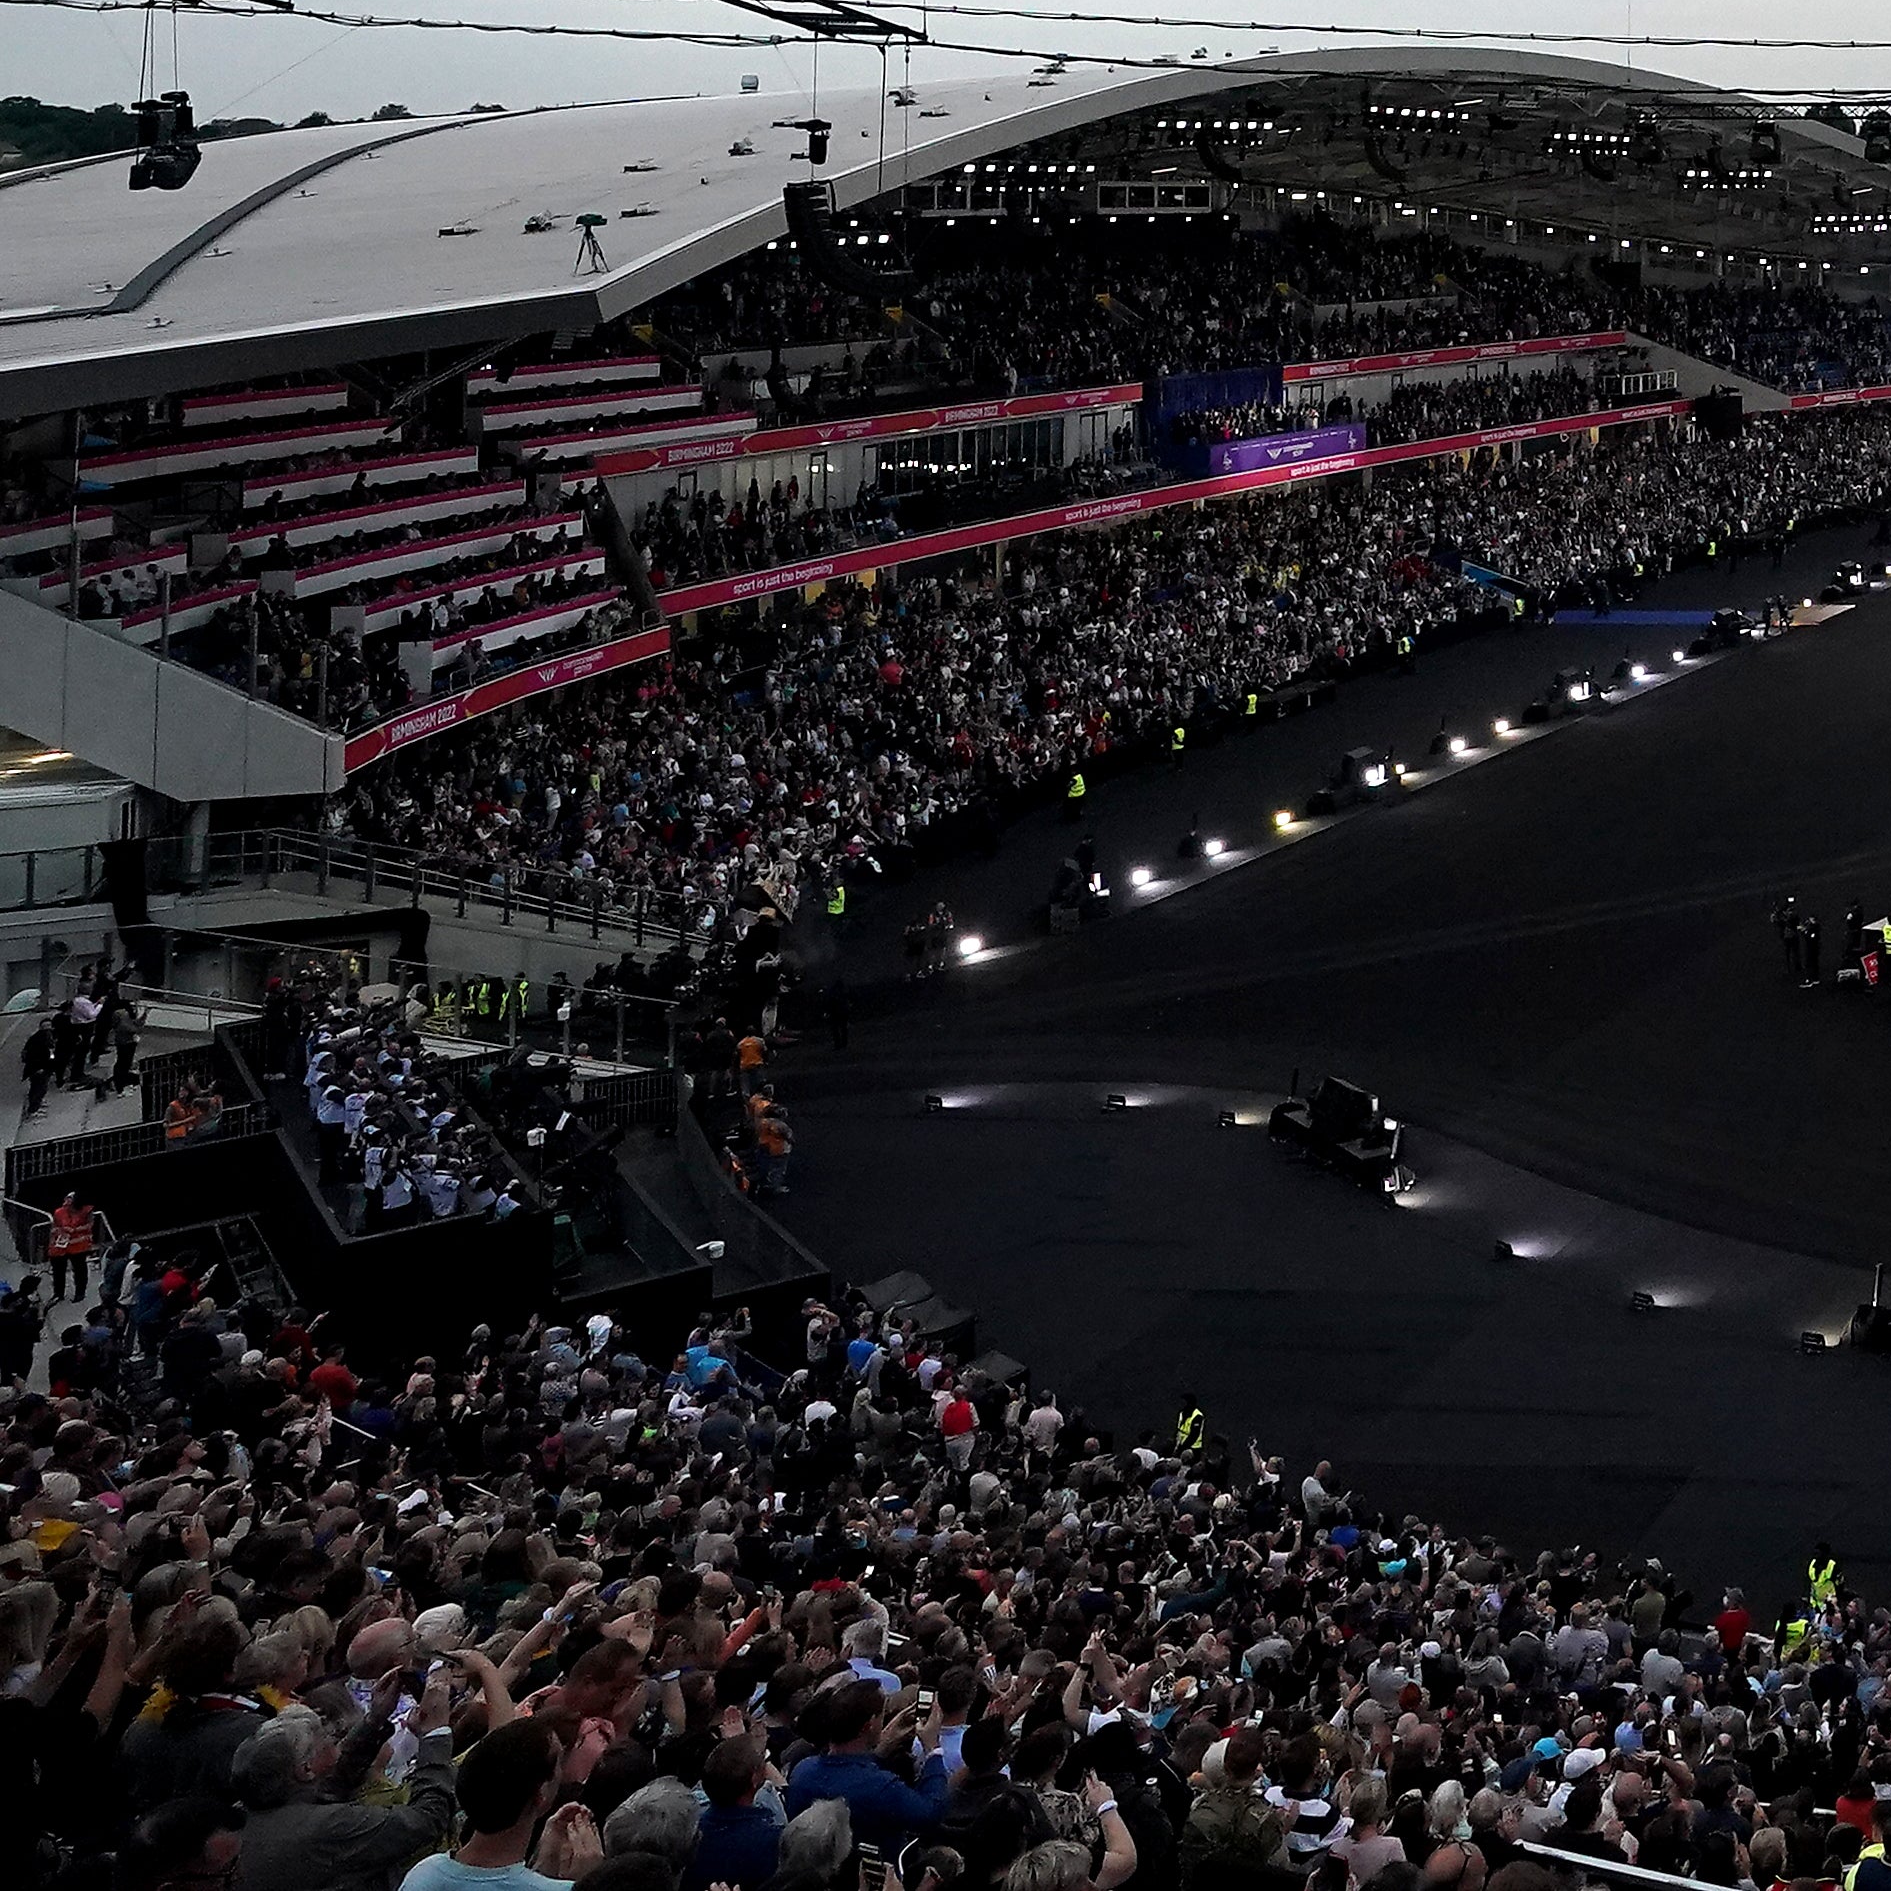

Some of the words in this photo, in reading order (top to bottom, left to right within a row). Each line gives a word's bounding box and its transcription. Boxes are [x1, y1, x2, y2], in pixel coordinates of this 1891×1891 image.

[668, 443, 715, 463] BIRMINGHAM
[716, 441, 734, 456] 2022
[733, 580, 755, 595] sport
[765, 572, 780, 590] just
[781, 571, 794, 582] the
[795, 563, 833, 580] beginning
[391, 711, 437, 743] BIRMINGHAM
[437, 704, 457, 724] 2022
